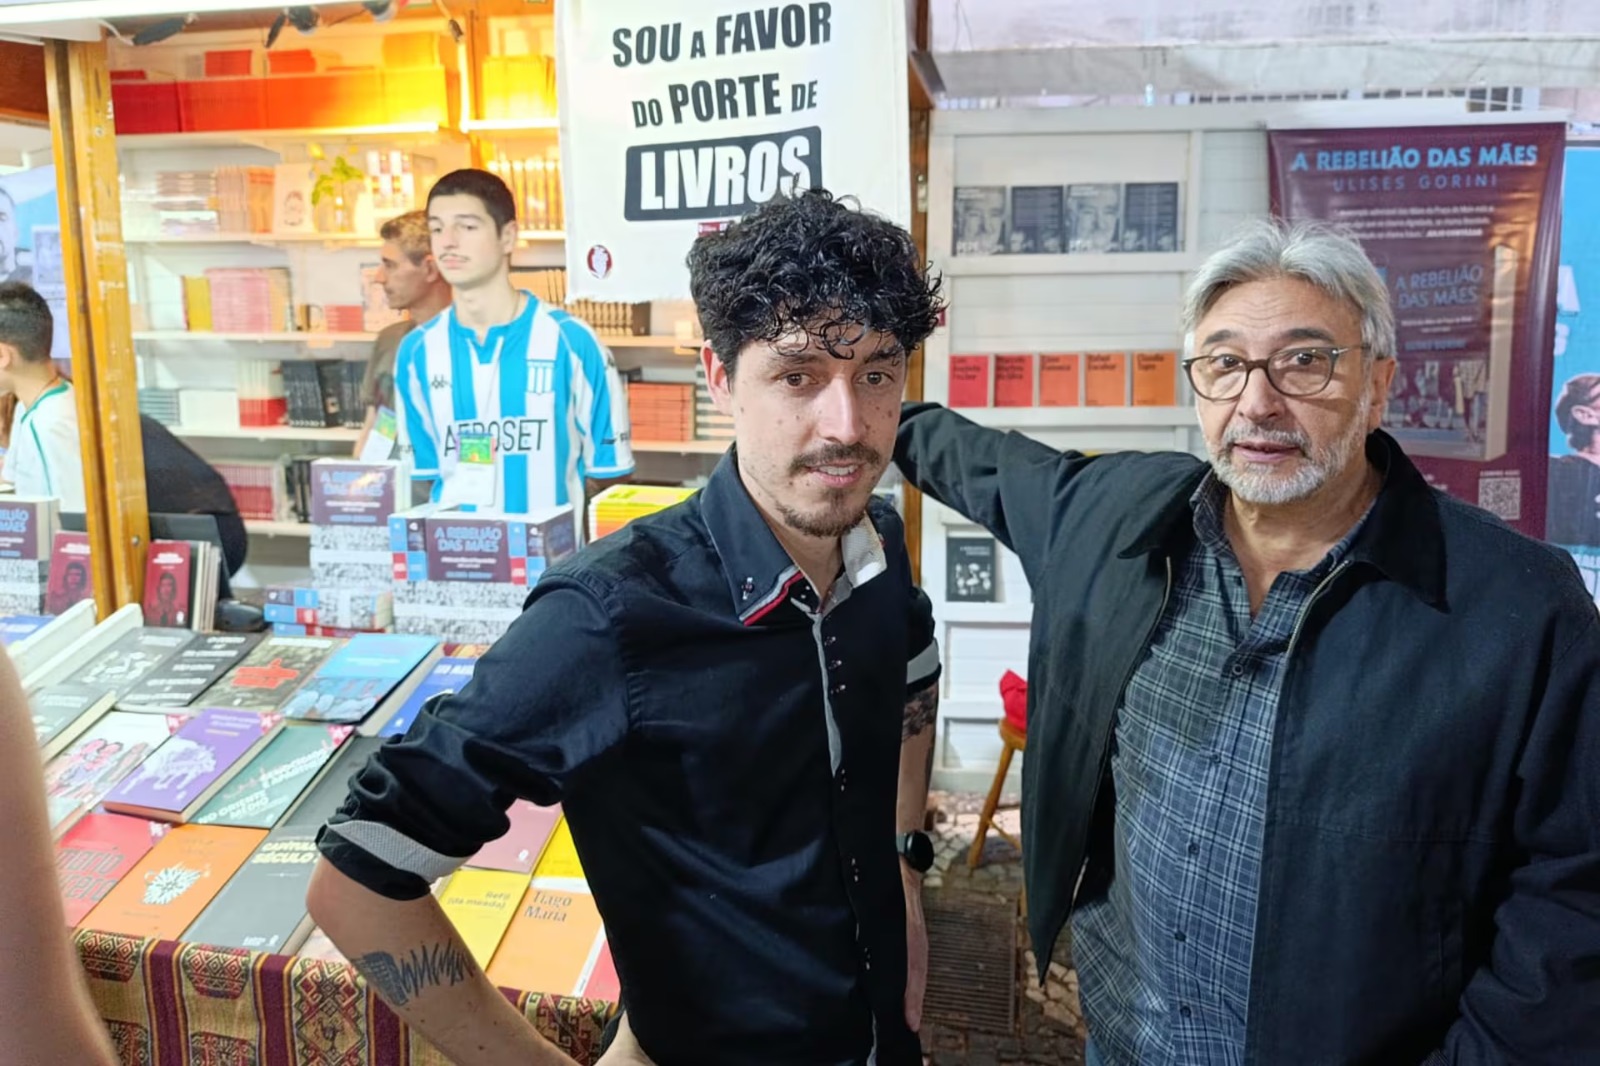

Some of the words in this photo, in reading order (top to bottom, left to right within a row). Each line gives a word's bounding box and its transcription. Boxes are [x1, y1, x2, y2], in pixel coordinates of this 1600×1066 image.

[612, 23, 682, 67] SOU
[690, 31, 706, 59] A
[716, 1, 832, 56] FAVOR
[631, 98, 663, 128] DO
[668, 73, 782, 124] PORTE
[791, 80, 818, 112] DE
[1291, 151, 1309, 171] A
[1317, 145, 1420, 171] REBELIÃO
[1427, 147, 1471, 168] DAS
[1478, 142, 1538, 166] MÃES
[640, 135, 811, 210] LIVROS
[1333, 176, 1405, 192] ULISES
[1419, 174, 1497, 189] GORINI
[524, 905, 567, 922] Maria
[533, 890, 573, 909] Tiago
